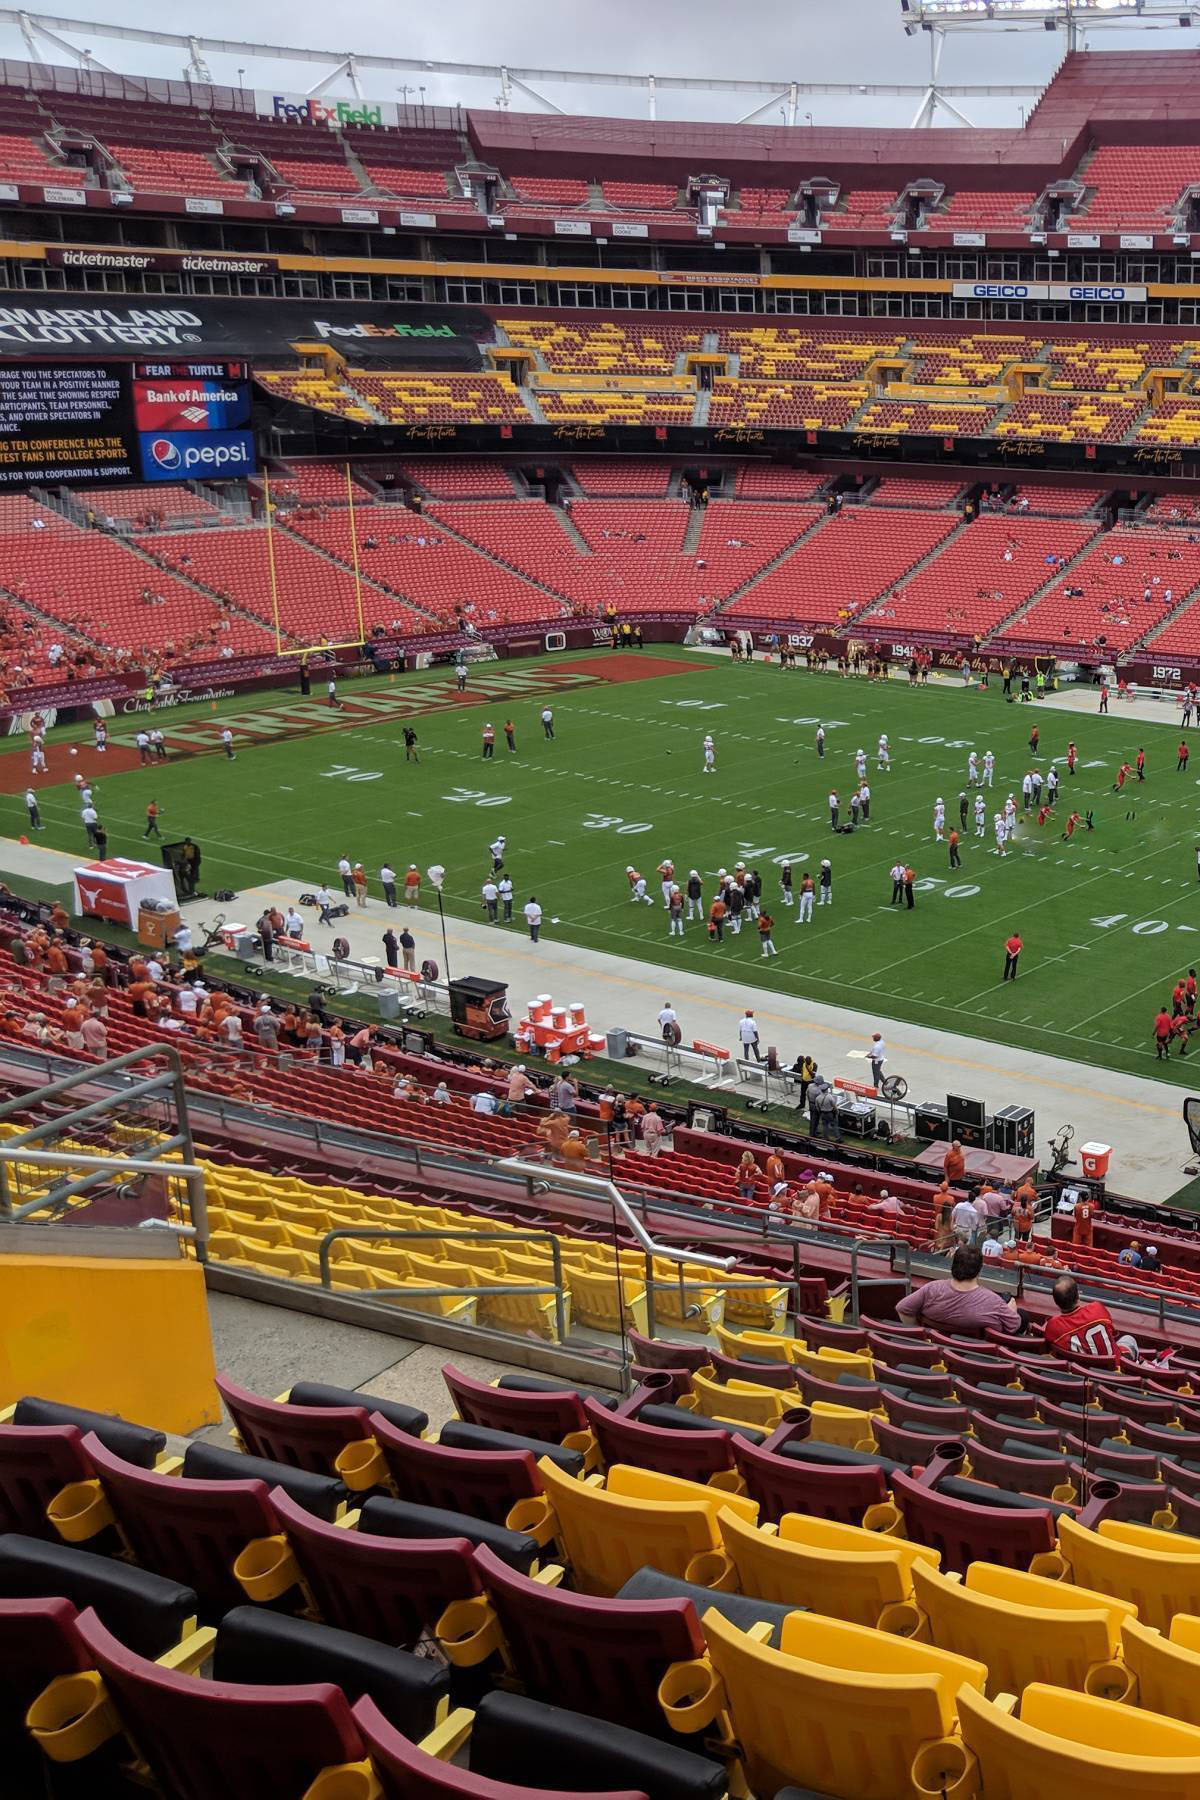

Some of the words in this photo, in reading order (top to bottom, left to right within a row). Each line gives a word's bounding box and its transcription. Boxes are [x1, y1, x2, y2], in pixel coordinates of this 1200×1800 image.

[273, 96, 382, 126] FedExField
[63, 252, 150, 269] ticketmaster
[182, 257, 264, 273] ticketmaster
[974, 286, 1028, 298] GEICO
[1069, 287, 1126, 300] GEICO
[313, 321, 457, 338] FedExField
[22, 371, 37, 380] YOU
[38, 371, 52, 380] THE
[54, 370, 96, 380] SPECTATORS
[98, 370, 107, 379] TO
[0, 381, 20, 390] YOUR
[21, 381, 42, 390] TEAM
[43, 381, 52, 390] IN
[52, 381, 58, 389] A
[59, 380, 91, 390] POSITIVE
[92, 380, 121, 389] MANNER
[2, 392, 17, 400] THE
[18, 392, 38, 400] SAME
[39, 392, 57, 400] TIME
[58, 392, 90, 400] SHOWING
[90, 390, 121, 400] RESPECT
[146, 390, 178, 403] Bank
[178, 390, 190, 402] of
[192, 390, 239, 402] America
[49, 402, 70, 410] TEAM
[70, 401, 112, 410] PERSONNEL,
[9, 413, 24, 422] AND
[25, 412, 48, 421] OTHER
[50, 412, 92, 421] SPECTATORS
[93, 411, 102, 420] IN
[11, 440, 29, 451] TEN
[30, 439, 86, 451] CONFERENCE
[87, 438, 105, 448] HAS
[106, 437, 122, 448] THE
[21, 452, 44, 462] FANS
[46, 452, 56, 462] IN
[56, 450, 95, 461] COLLEGE
[95, 449, 128, 460] SPORTS
[9, 472, 24, 481] FOR
[24, 472, 45, 480] YOUR
[46, 468, 93, 480] COOPERATION
[94, 468, 100, 478] &
[788, 634, 815, 647] 1937
[1153, 666, 1181, 680] 1972
[1088, 914, 1169, 935] 40
